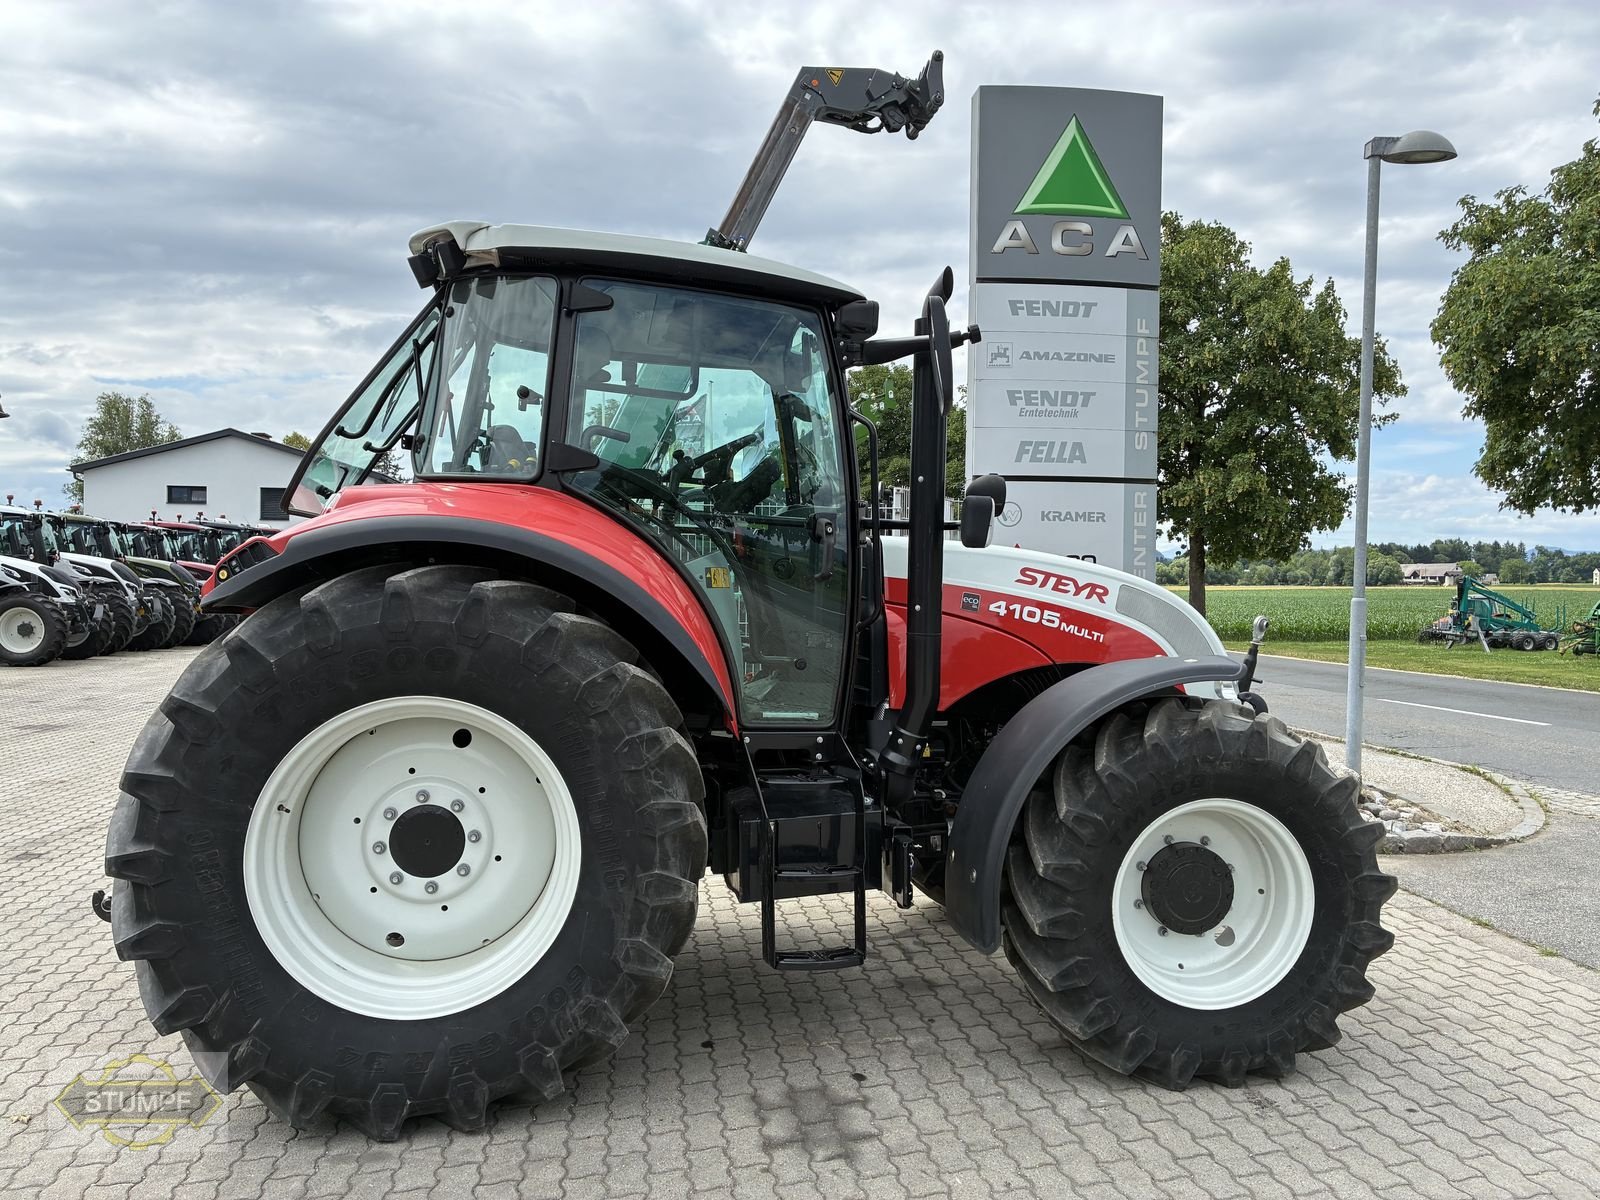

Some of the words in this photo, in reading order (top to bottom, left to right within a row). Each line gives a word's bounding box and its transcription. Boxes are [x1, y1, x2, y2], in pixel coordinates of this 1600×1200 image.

[991, 220, 1149, 260] ACA
[1008, 299, 1098, 318] FENDT
[1019, 350, 1115, 363] AMAZONE
[1135, 318, 1150, 450] STUMPF
[1006, 389, 1096, 407] FENDT
[1019, 408, 1079, 418] Erntetechnik
[1014, 440, 1087, 463] FELLA
[1041, 511, 1106, 522] KRAMER
[1015, 567, 1109, 604] STEYR
[963, 596, 979, 604] eco
[988, 601, 1061, 628] 4105
[1060, 622, 1104, 643] MULTI
